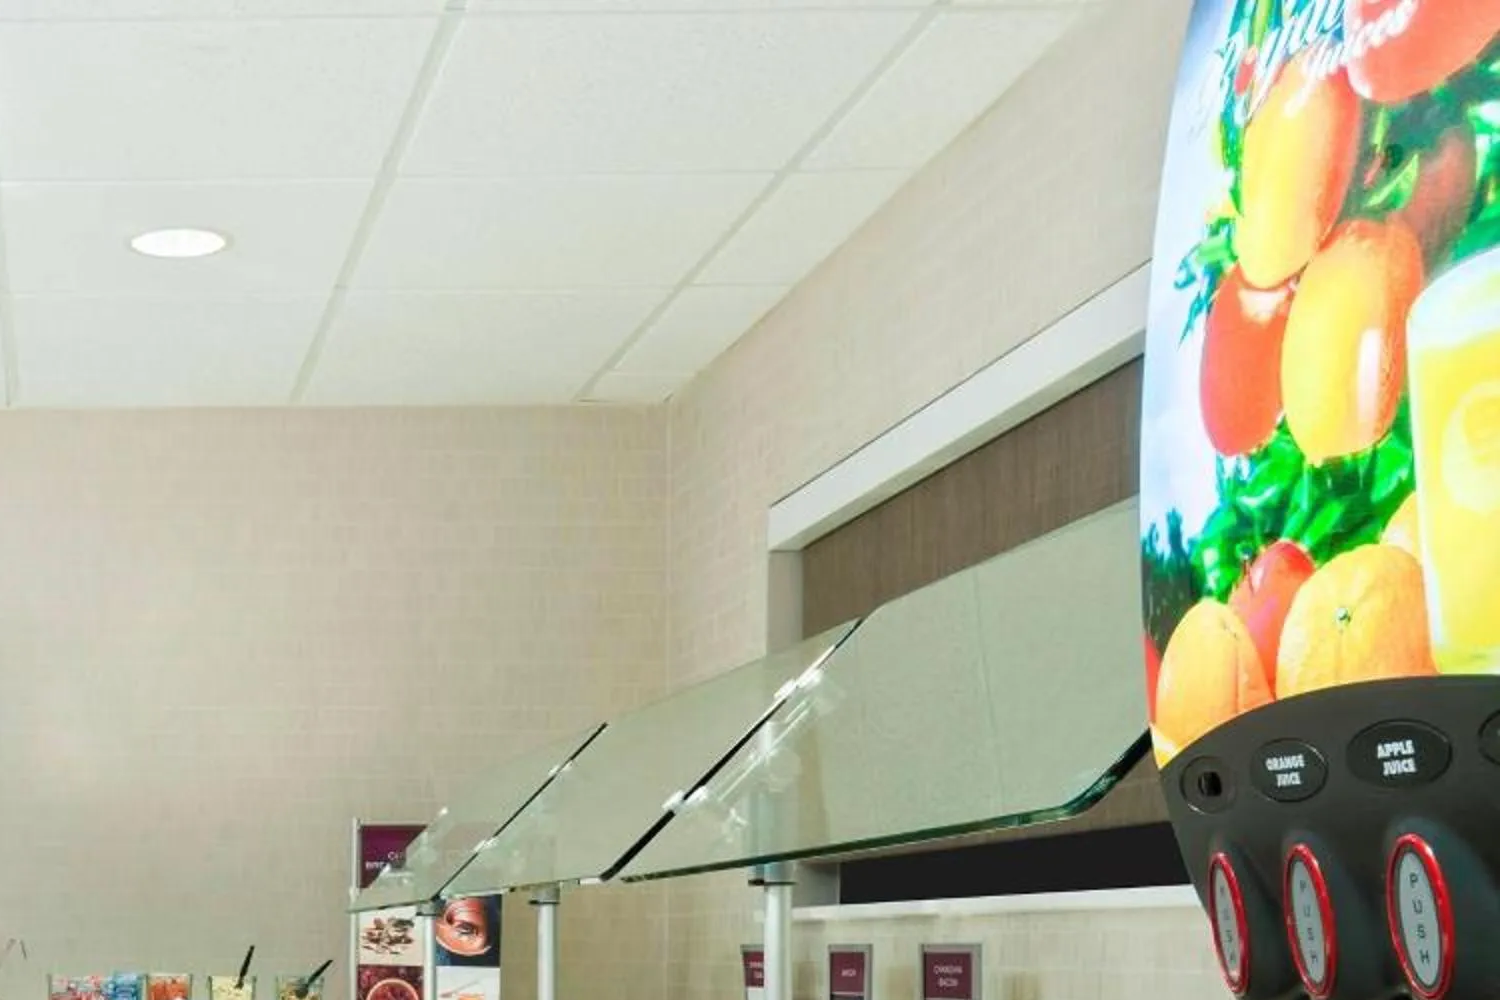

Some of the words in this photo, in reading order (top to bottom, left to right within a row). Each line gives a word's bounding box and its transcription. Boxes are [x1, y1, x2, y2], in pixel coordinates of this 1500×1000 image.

[1377, 739, 1415, 759] APPLE
[1265, 754, 1305, 771] ORANGE
[1383, 758, 1417, 776] JUICE
[1276, 771, 1302, 787] JUICE
[1299, 879, 1319, 964] PUSH
[1409, 872, 1431, 965] PUSH
